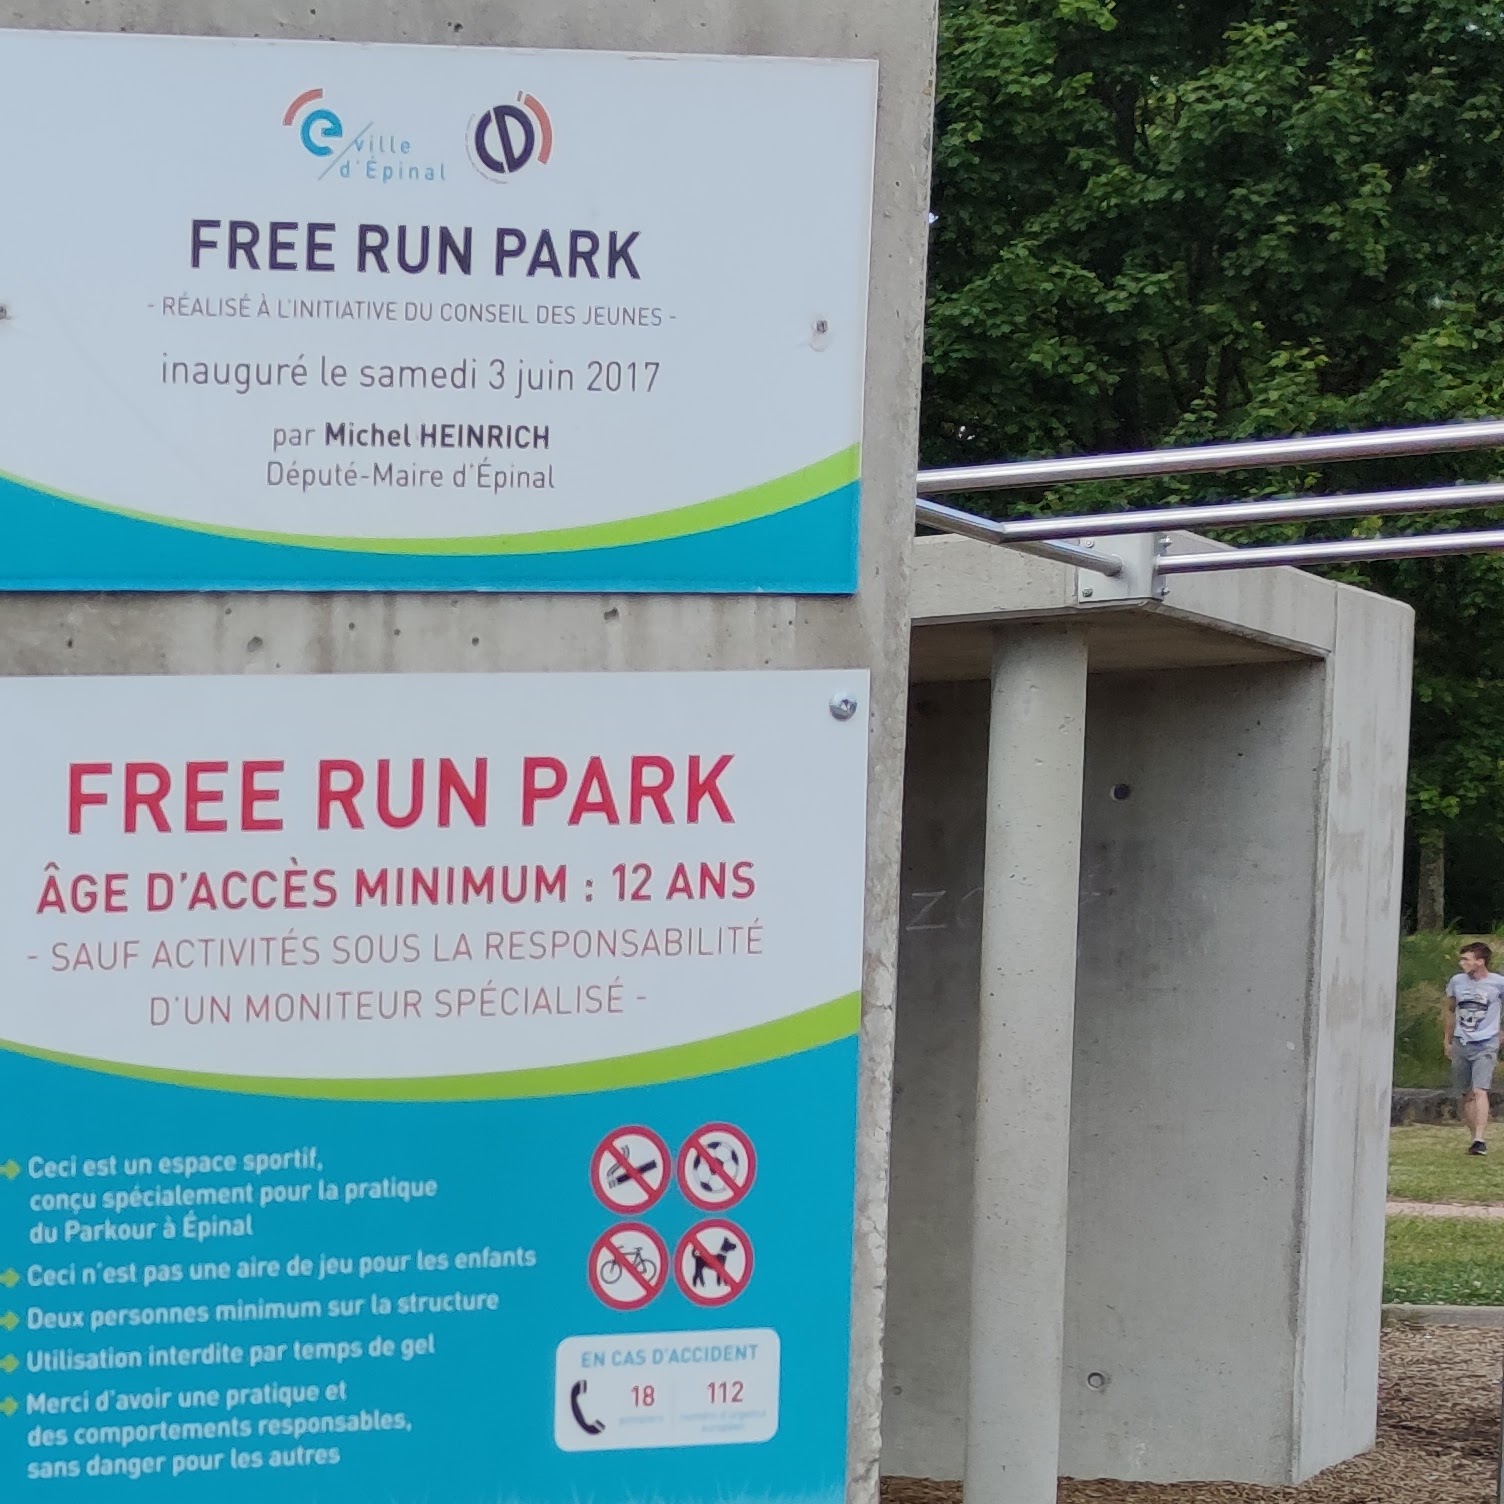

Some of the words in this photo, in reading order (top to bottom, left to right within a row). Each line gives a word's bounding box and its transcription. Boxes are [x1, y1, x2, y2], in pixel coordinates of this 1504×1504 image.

[353, 134, 411, 154] ville
[340, 155, 447, 183] d'Épinal
[191, 220, 336, 272] FREE
[357, 223, 473, 276] RUN
[495, 227, 642, 280] PARK
[162, 291, 251, 318] RÉALISÉ
[257, 293, 270, 318] À
[278, 299, 398, 321] L'INITIATIVE
[404, 302, 432, 321] DU
[441, 303, 528, 323] CONSEIL
[537, 305, 576, 324] DES
[582, 306, 662, 326] JEUNES
[162, 353, 307, 394] inauguré
[321, 356, 347, 386] le
[359, 357, 476, 388] samedi
[489, 359, 505, 390] 3
[515, 359, 573, 399] juin
[586, 361, 660, 392] 2017
[273, 428, 316, 452] par
[324, 422, 412, 448] Michel
[420, 424, 550, 450] HEINRICH
[267, 460, 444, 492] Député-Maire
[452, 457, 555, 494] d'Épinal
[67, 760, 286, 835] FREE
[316, 757, 488, 832] RUN
[520, 755, 737, 826] PARK
[36, 862, 129, 915] ÂGE
[146, 857, 338, 912] D'ACCÈS
[354, 864, 567, 908] MINIMUM
[611, 862, 653, 902] 12
[666, 861, 756, 901] ANS
[51, 940, 140, 972] SAUF
[152, 928, 321, 970] ACTIVITÉS
[332, 933, 421, 965] SOUS
[433, 933, 473, 962] LA
[485, 918, 764, 961] RESPONSABILITÉ
[150, 995, 231, 1026] D'UN
[246, 989, 423, 1023] MONITEUR
[434, 976, 624, 1018] SPÉCIALISÉ
[28, 1155, 77, 1178] Ceci
[83, 1155, 117, 1177] est
[124, 1157, 152, 1175] un
[159, 1155, 237, 1179] espace
[243, 1146, 323, 1175] sportif,
[30, 1193, 96, 1214] conçu
[102, 1182, 253, 1214] spécialement
[260, 1185, 312, 1208] pour
[318, 1178, 339, 1201] la
[345, 1176, 438, 1204] pratique
[30, 1221, 58, 1244] du
[64, 1216, 158, 1242] Parkour
[162, 1215, 176, 1239] à
[183, 1209, 253, 1243] Épinal
[27, 1262, 75, 1286] Ceci
[82, 1261, 136, 1284] n'est
[144, 1262, 183, 1287] pas
[190, 1261, 230, 1281] une
[237, 1255, 280, 1278] aire
[287, 1254, 313, 1277] de
[319, 1252, 353, 1280] jeu
[359, 1255, 411, 1278] pour
[417, 1249, 448, 1271] les
[455, 1246, 537, 1269] enfants
[27, 1307, 84, 1330] Deux
[91, 1304, 209, 1333] personnes
[216, 1297, 322, 1322] minimum
[328, 1299, 366, 1317] sur
[371, 1293, 392, 1315] la
[398, 1291, 499, 1314] structure
[27, 1346, 141, 1372] Utilisation
[148, 1342, 243, 1367] interdite
[250, 1344, 288, 1367] par
[293, 1341, 363, 1364] temps
[369, 1335, 394, 1358] de
[401, 1333, 435, 1361] gel
[581, 1351, 605, 1368] EN
[612, 1348, 646, 1366] CAS
[653, 1344, 759, 1365] D'ACCIDENT
[26, 1390, 89, 1415] Merci
[96, 1387, 173, 1412] d'avoir
[178, 1389, 220, 1408] une
[226, 1381, 320, 1411] pratique
[325, 1379, 347, 1400] et
[631, 1385, 655, 1407] 18
[707, 1381, 744, 1404] 112
[27, 1425, 68, 1447] des
[74, 1416, 252, 1448] comportements
[258, 1409, 412, 1439] responsables,
[27, 1460, 80, 1479] sans
[86, 1453, 166, 1479] danger
[172, 1453, 225, 1477] pour
[231, 1447, 263, 1469] les
[269, 1445, 341, 1467] autres
